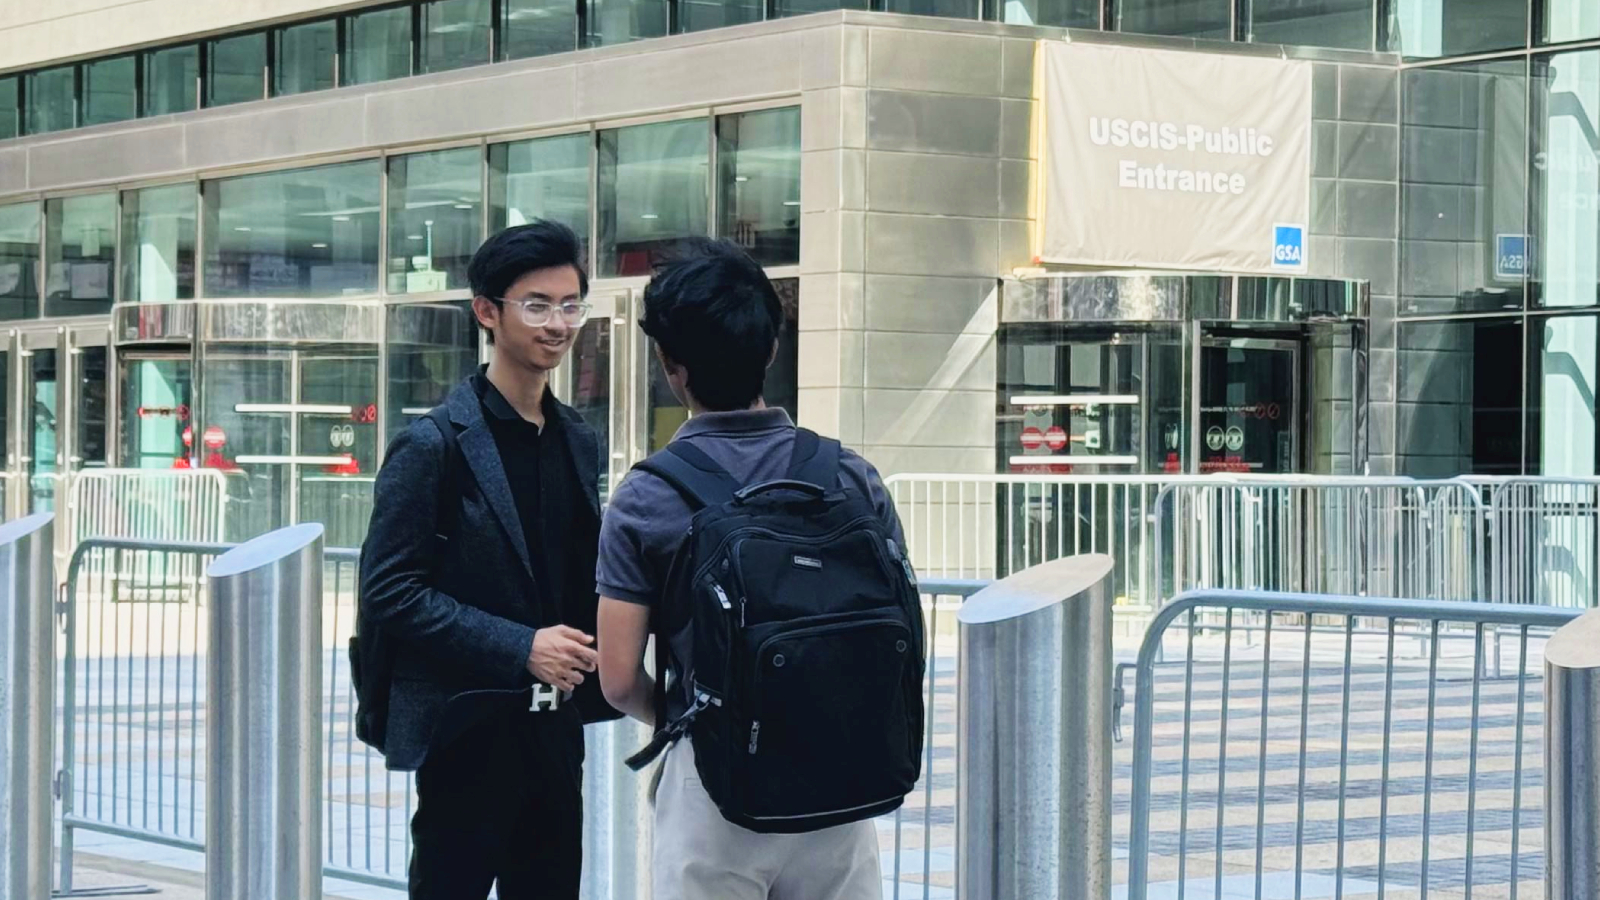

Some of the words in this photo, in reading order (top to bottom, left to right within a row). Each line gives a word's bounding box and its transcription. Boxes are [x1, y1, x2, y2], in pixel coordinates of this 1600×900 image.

[1089, 117, 1273, 156] USCIS-Public
[1119, 160, 1246, 194] Entrance
[1275, 244, 1301, 261] GSA
[529, 683, 558, 712] H
